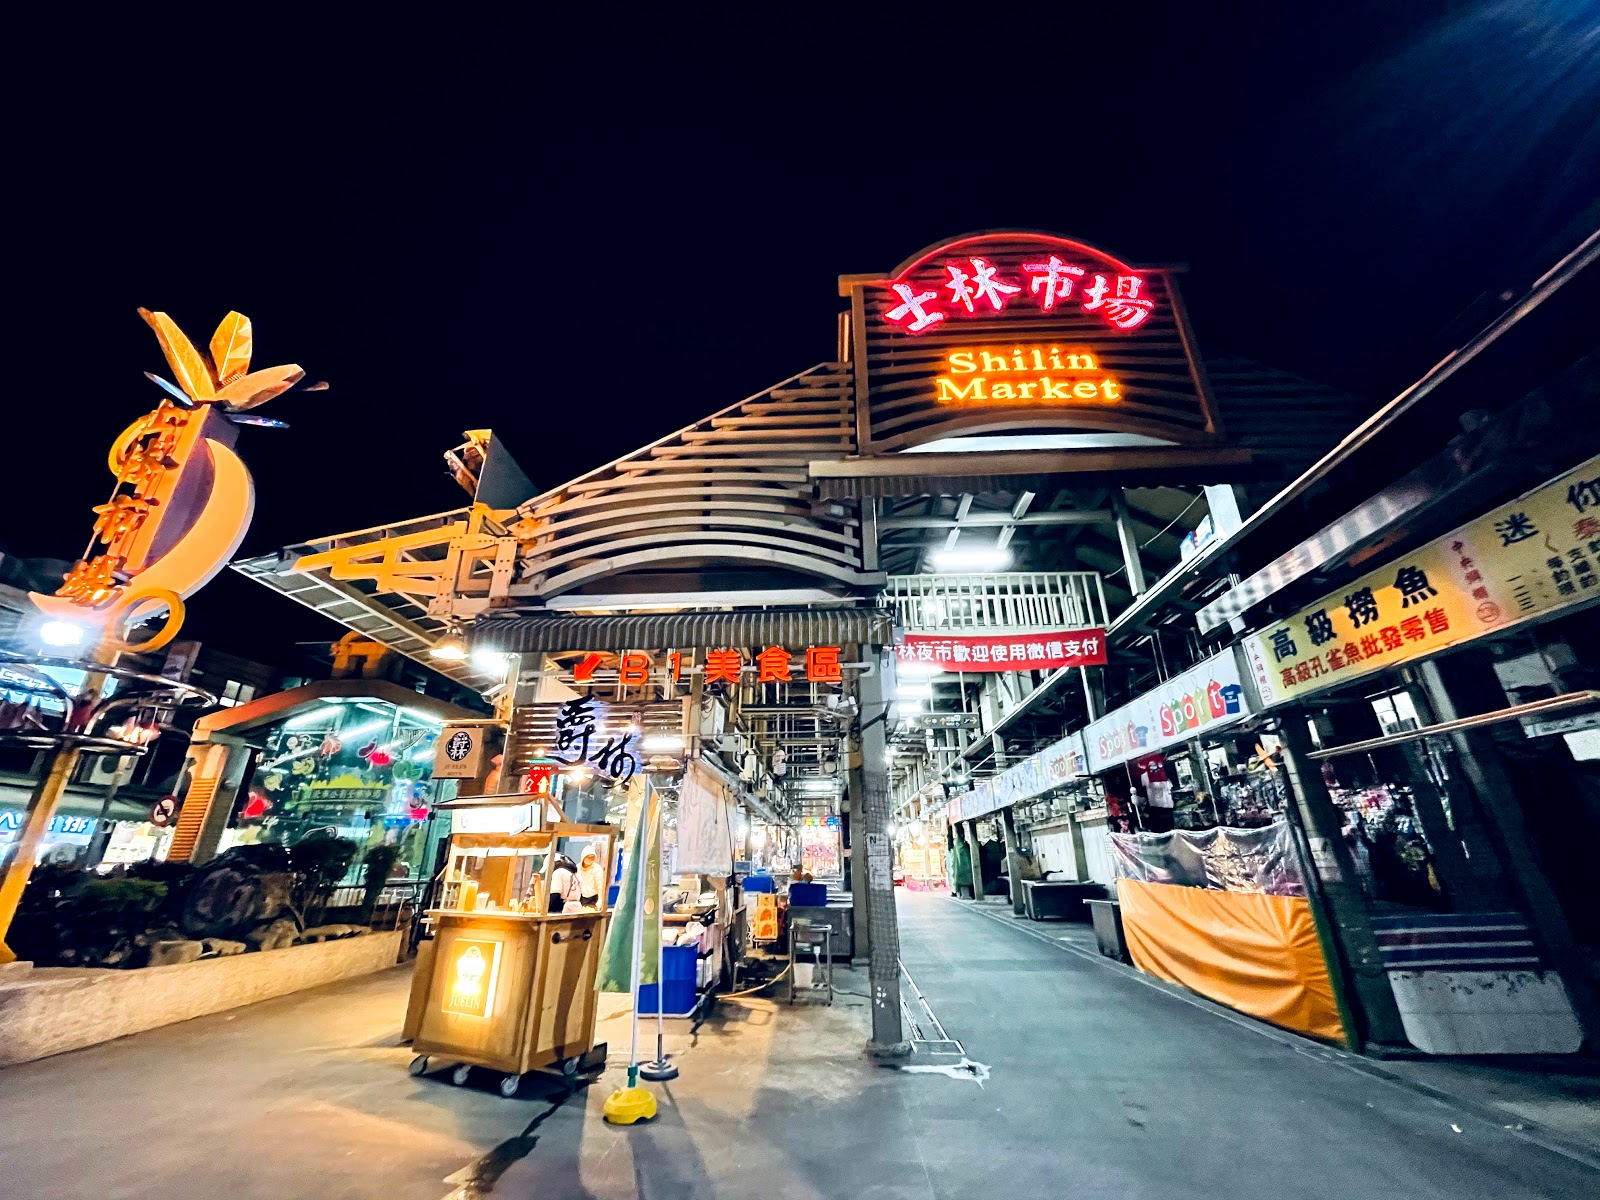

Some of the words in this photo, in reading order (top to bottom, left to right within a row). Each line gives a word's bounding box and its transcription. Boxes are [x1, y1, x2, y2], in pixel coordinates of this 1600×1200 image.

[885, 256, 1154, 331] 士林市場
[948, 347, 1099, 374] Shilin
[936, 378, 1121, 402] Market
[1268, 565, 1438, 663] 高級撈魚
[882, 637, 1098, 662] 林夜市歡迎使用微信支付
[1279, 607, 1450, 689] 高級孔雀魚批發零售
[1161, 690, 1221, 735] Sport
[448, 994, 480, 1009] JUELIN
